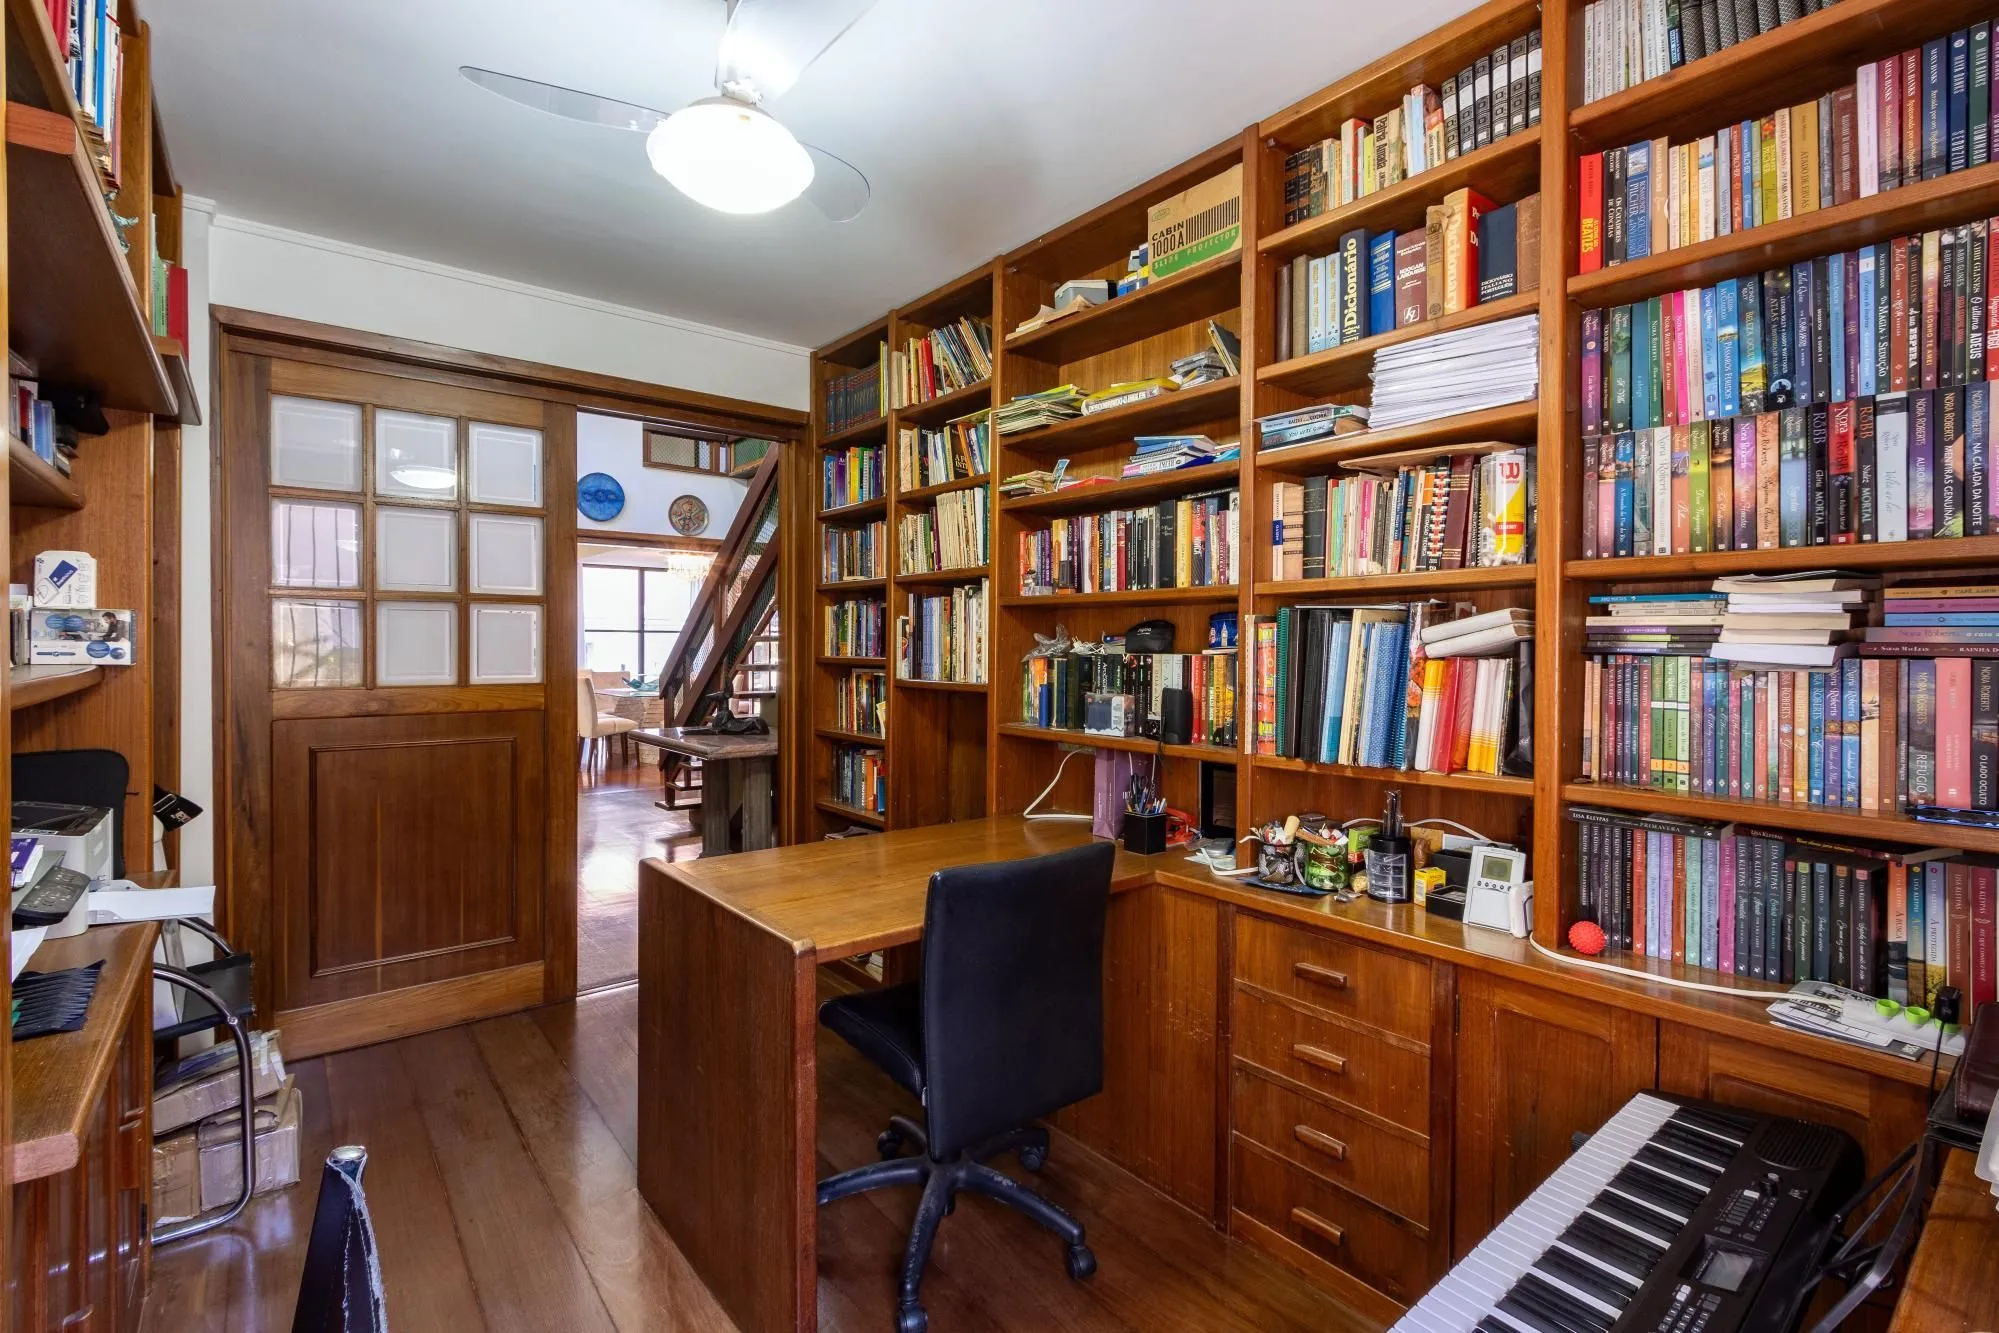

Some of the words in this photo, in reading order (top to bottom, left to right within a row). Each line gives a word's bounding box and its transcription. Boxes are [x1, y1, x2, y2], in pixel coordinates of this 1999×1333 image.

[1376, 116, 1388, 142] Pátria
[1376, 144, 1388, 170] Amada
[1152, 220, 1184, 242] CABIN
[1582, 218, 1593, 253] BEATLES
[1344, 238, 1357, 329] Dicionário
[1876, 342, 1888, 377] SEDUÇÃO
[1908, 327, 1918, 369] ESPERA
[1970, 332, 1982, 360] ADEUS
[1916, 398, 1926, 416] NORA
[1944, 392, 1955, 412] NORA
[1972, 390, 1982, 410] NORA
[1813, 412, 1826, 445] ROBB
[1916, 418, 1926, 446] ROBERTS
[1944, 414, 1955, 442] ROBERTS
[1972, 442, 1982, 454] NA
[1916, 456, 1926, 488] AURORA
[1944, 446, 1953, 484] MENTIRAS
[1972, 456, 1982, 487] CALADA
[1862, 488, 1872, 522] MORTAL
[1944, 486, 1955, 526] GENUÍNAS
[1972, 488, 1982, 499] DA
[1816, 492, 1824, 526] MORTAL
[1972, 502, 1982, 526] NOITE
[1980, 685, 1990, 712] ROBERTS
[1916, 754, 1928, 792] REFÚGIO
[1979, 762, 1988, 778] LADO
[1978, 780, 1988, 806] OCULTO
